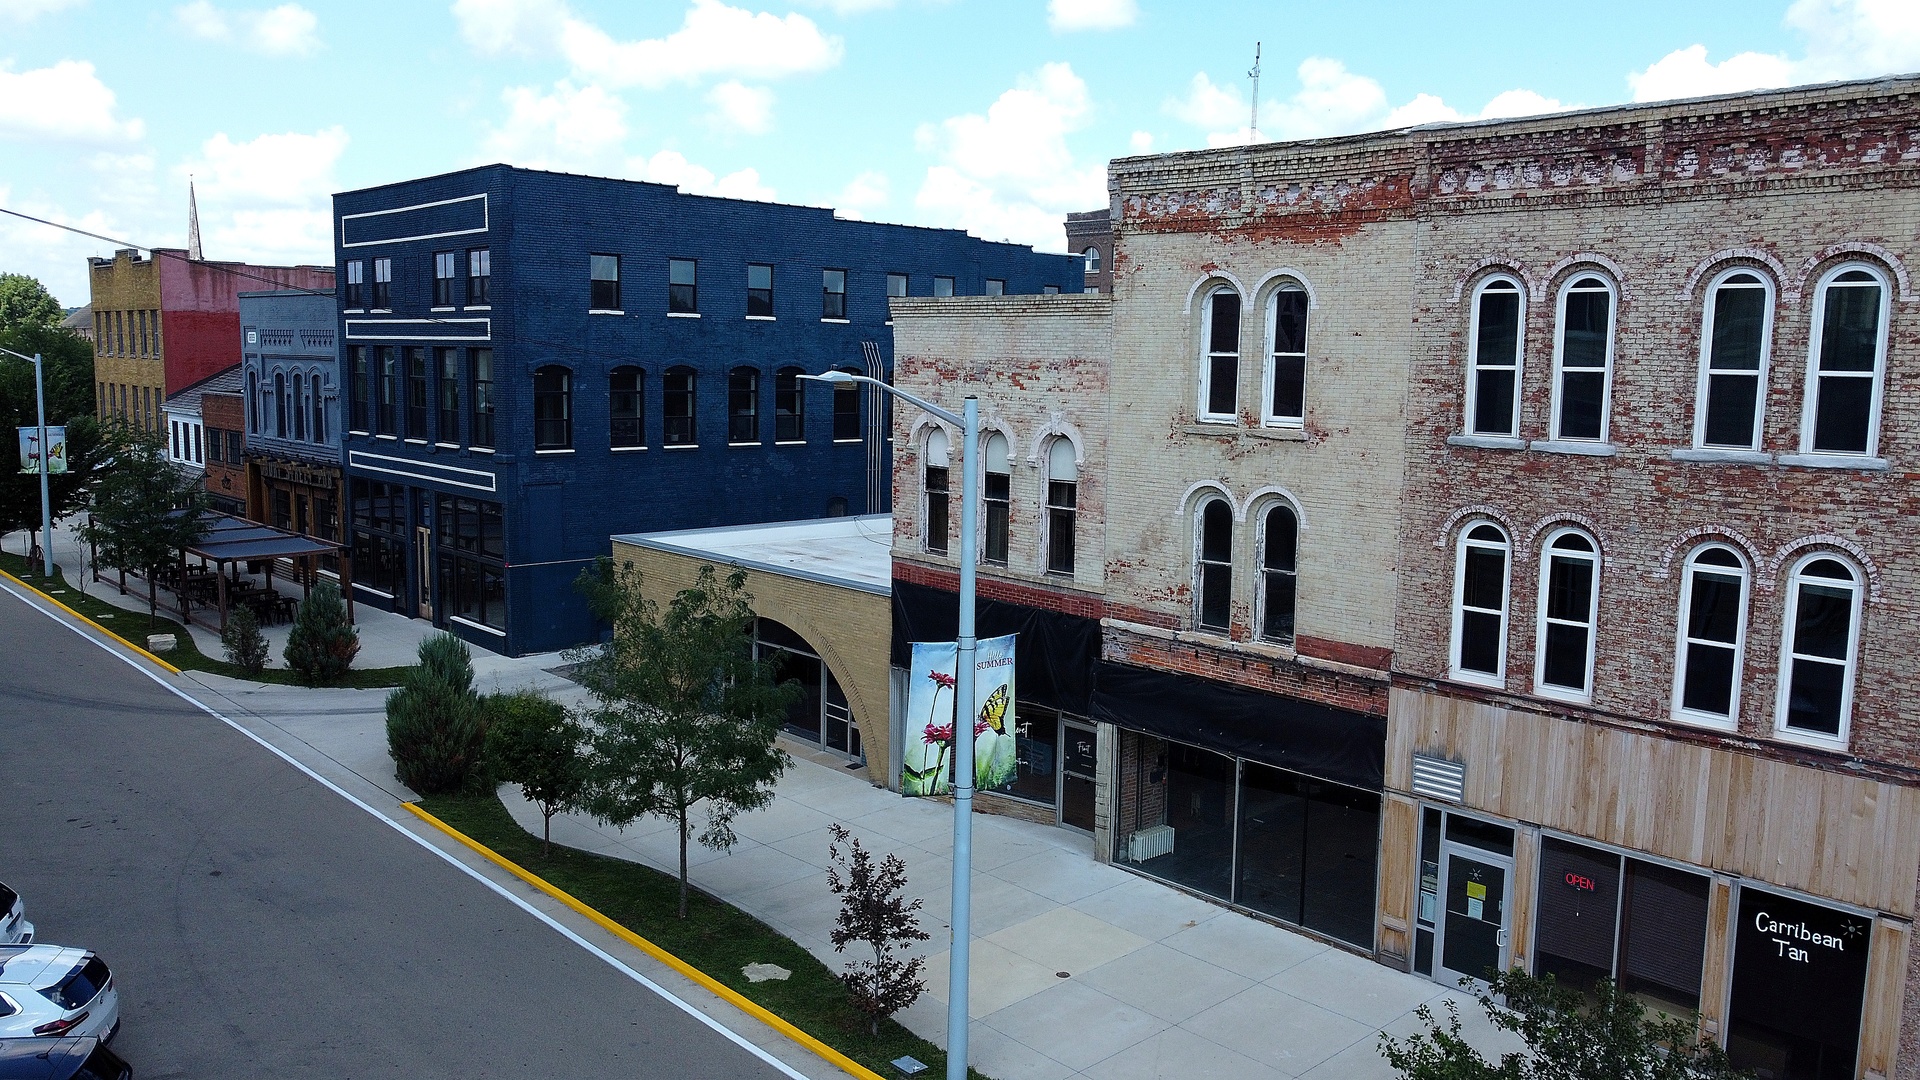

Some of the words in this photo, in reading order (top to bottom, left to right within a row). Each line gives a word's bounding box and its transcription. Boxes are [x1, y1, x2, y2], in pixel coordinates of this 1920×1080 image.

[976, 657, 1014, 671] SUMMER
[1565, 873, 1595, 891] OPEN
[1755, 911, 1845, 951] Carribean
[1772, 938, 1810, 964] Tan
